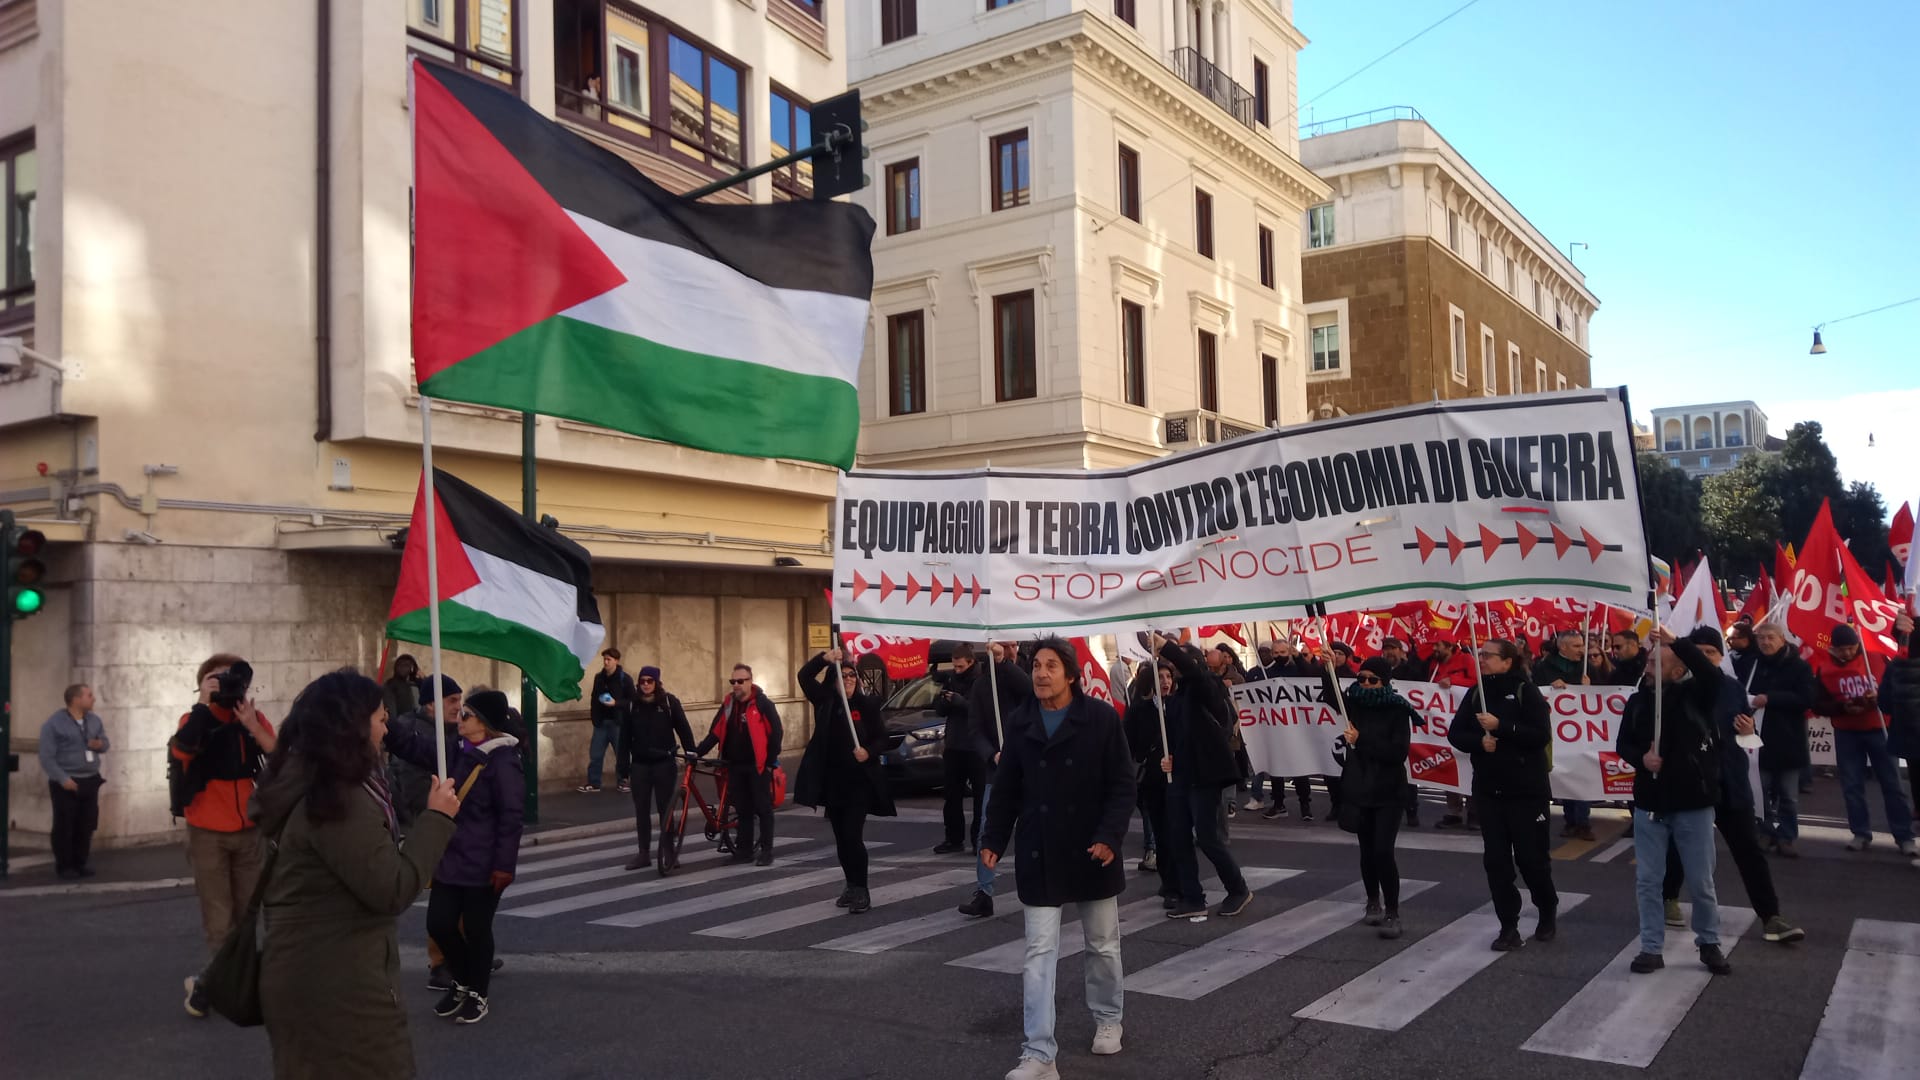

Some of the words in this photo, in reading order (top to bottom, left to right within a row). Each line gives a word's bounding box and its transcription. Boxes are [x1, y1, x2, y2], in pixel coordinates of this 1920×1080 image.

[842, 499, 985, 559] EQUIPAGGIO
[989, 500, 1019, 554] DI
[1026, 501, 1120, 556] TERRA
[1125, 476, 1239, 555] CONTRO
[1236, 443, 1430, 527] L'ECONOMIA
[1425, 438, 1467, 503] DI
[1467, 431, 1626, 502] GUERRA
[1014, 573, 1123, 601] STOP
[1136, 533, 1379, 592] GENOCIDE
[1543, 693, 1628, 715] CUO
[1412, 749, 1452, 774] COBAS
